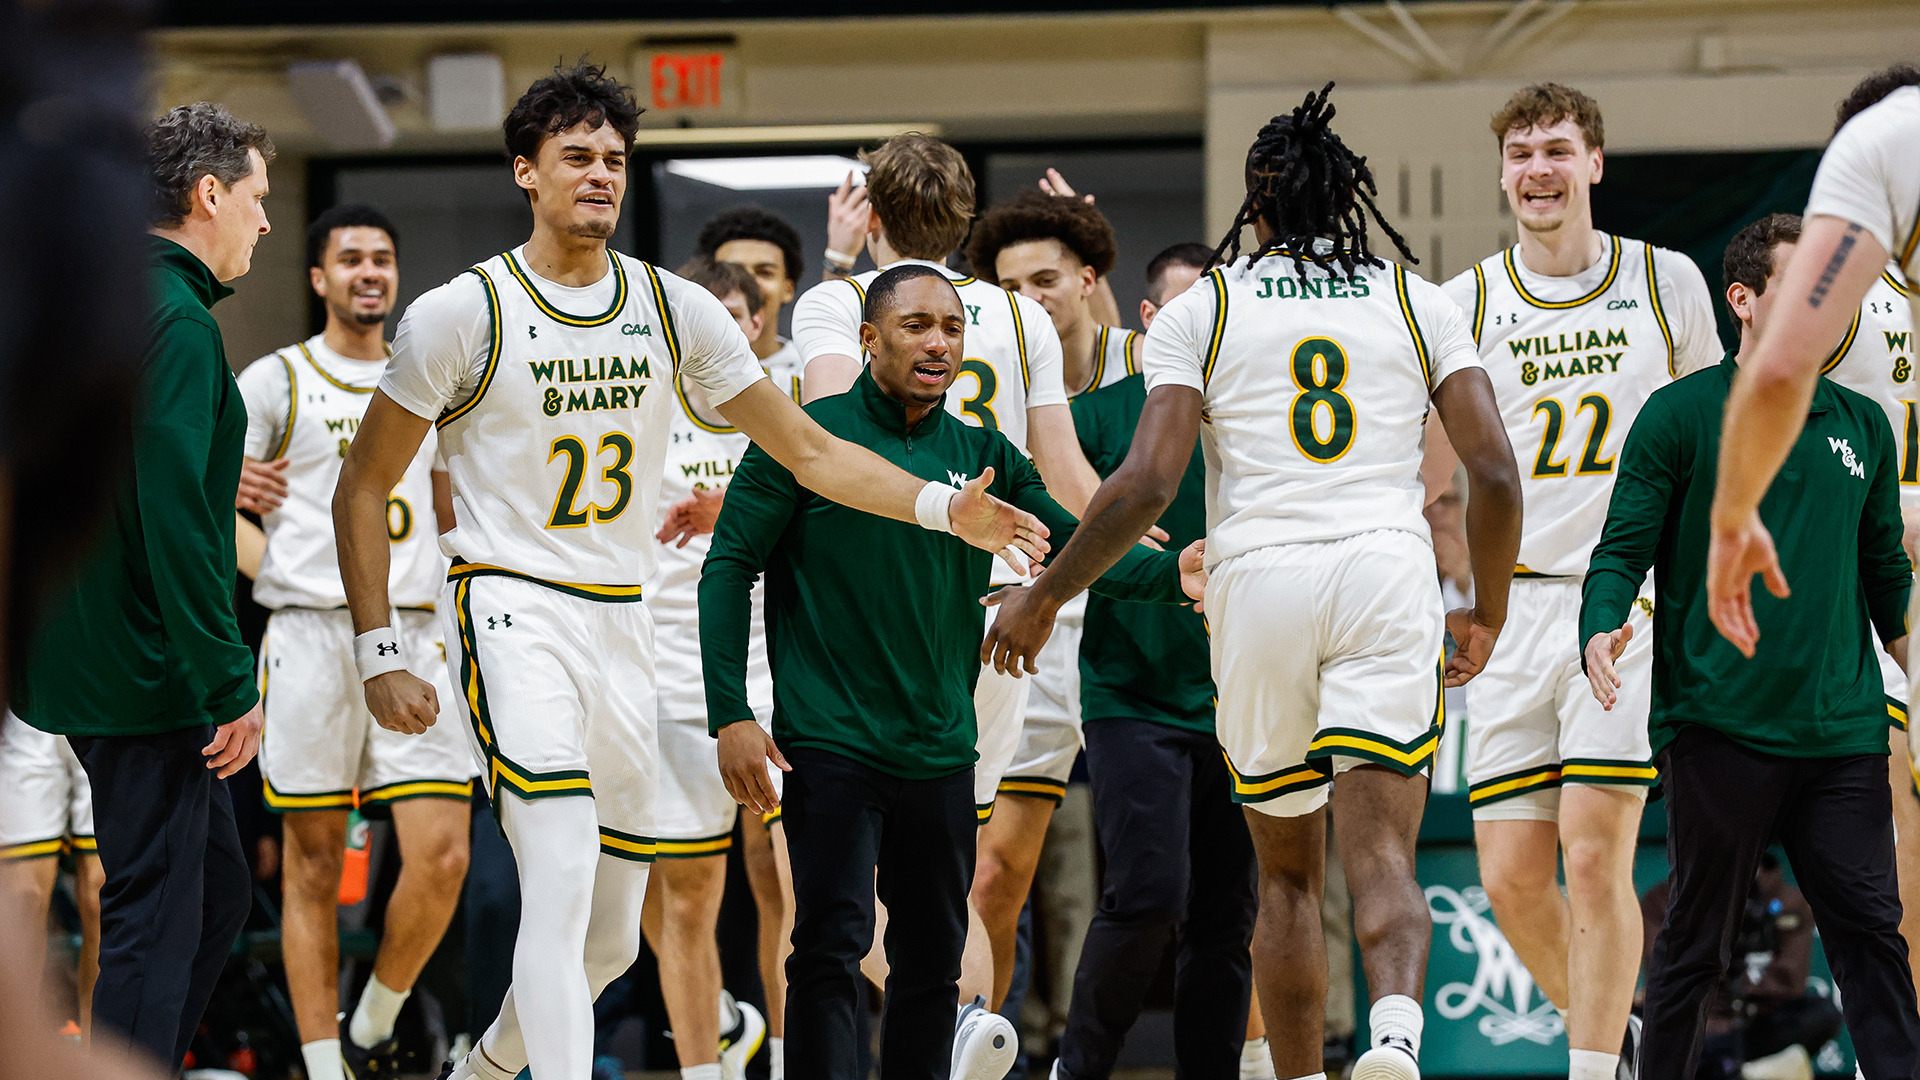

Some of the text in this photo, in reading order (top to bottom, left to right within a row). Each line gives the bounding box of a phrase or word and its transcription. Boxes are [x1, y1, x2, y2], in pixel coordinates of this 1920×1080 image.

[650, 52, 724, 110] EXIT
[1256, 275, 1370, 299] JONES
[1607, 300, 1638, 311] CAA
[621, 323, 652, 337] CAA
[1508, 325, 1631, 360] WILLIAM
[527, 354, 653, 386] WILLIAM
[1289, 335, 1357, 464] 8
[1530, 392, 1617, 479] 22
[544, 430, 636, 530] 23
[680, 458, 736, 477] WILL
